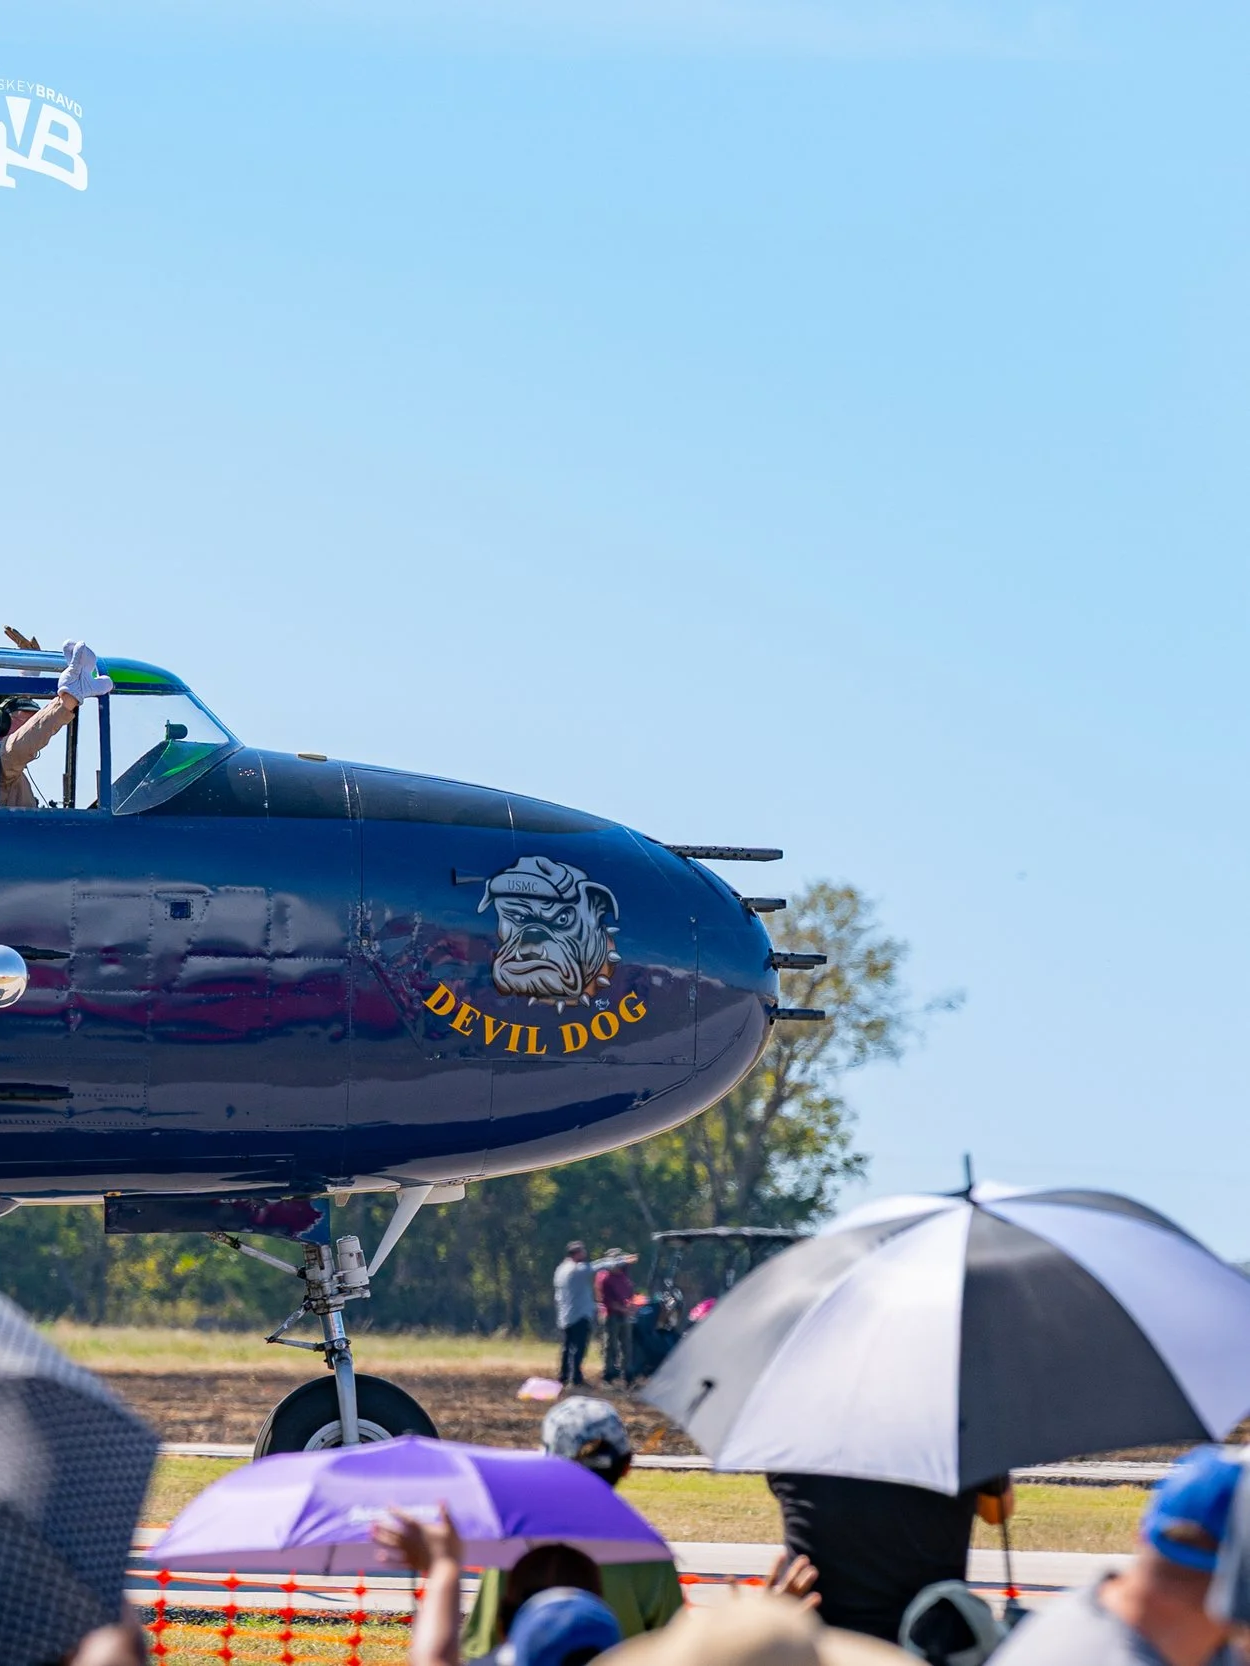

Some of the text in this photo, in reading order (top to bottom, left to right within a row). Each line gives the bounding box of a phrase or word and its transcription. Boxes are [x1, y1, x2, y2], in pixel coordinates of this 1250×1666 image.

[507, 879, 538, 893] USMC
[423, 982, 647, 1055] DEVIL DOG
